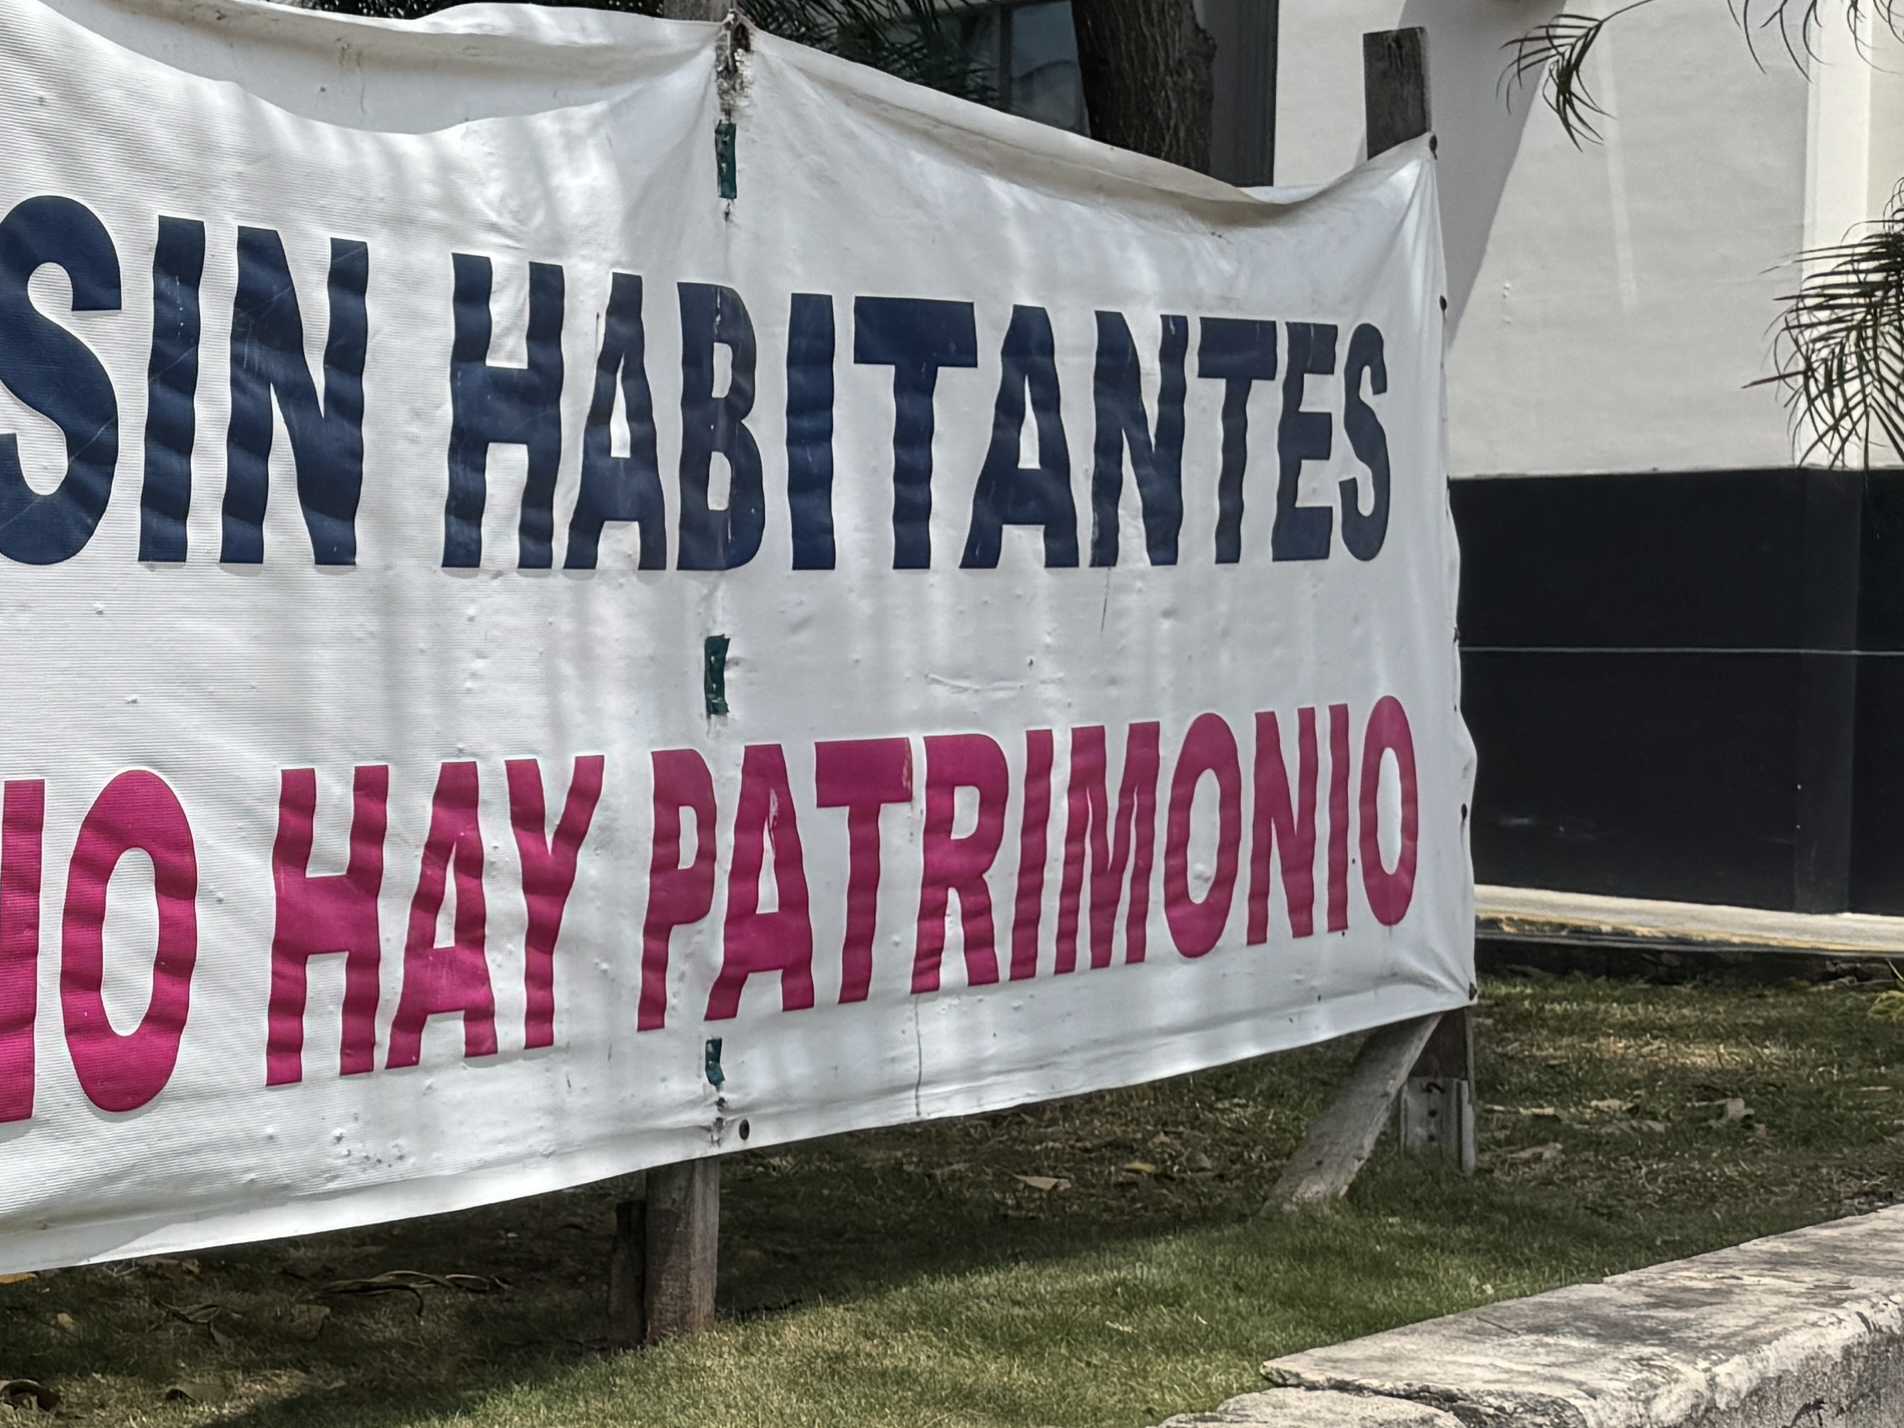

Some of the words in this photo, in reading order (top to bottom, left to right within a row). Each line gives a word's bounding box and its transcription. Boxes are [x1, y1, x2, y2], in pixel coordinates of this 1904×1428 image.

[440, 252, 1392, 572] HABITANTES
[265, 755, 605, 1087] HAY
[635, 694, 1419, 1032] PATRIMONIO
